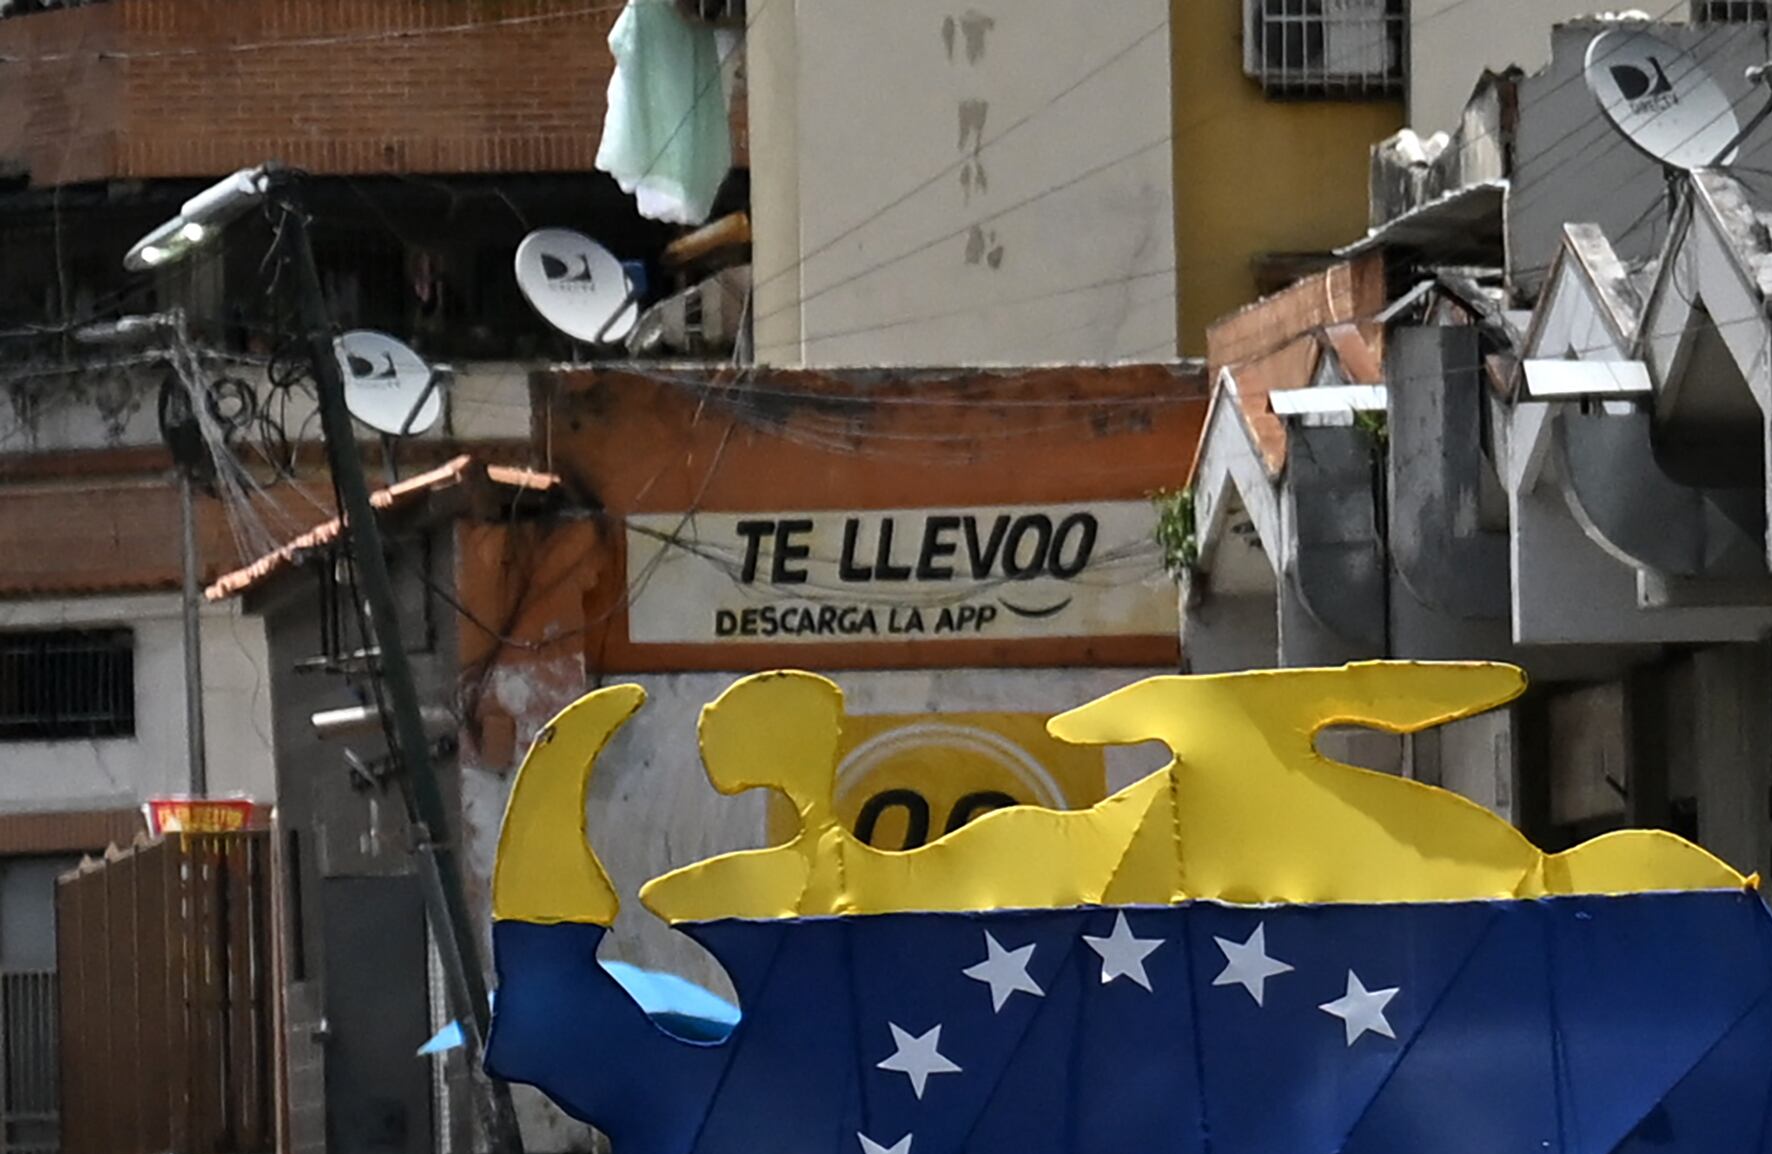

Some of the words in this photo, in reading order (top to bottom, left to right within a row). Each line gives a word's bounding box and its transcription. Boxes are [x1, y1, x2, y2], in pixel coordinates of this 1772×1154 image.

[735, 519, 813, 584] TE
[838, 512, 1099, 582] LLEVOO
[714, 604, 878, 637] DESCARGA
[888, 609, 925, 634] LA
[934, 605, 997, 633] APP
